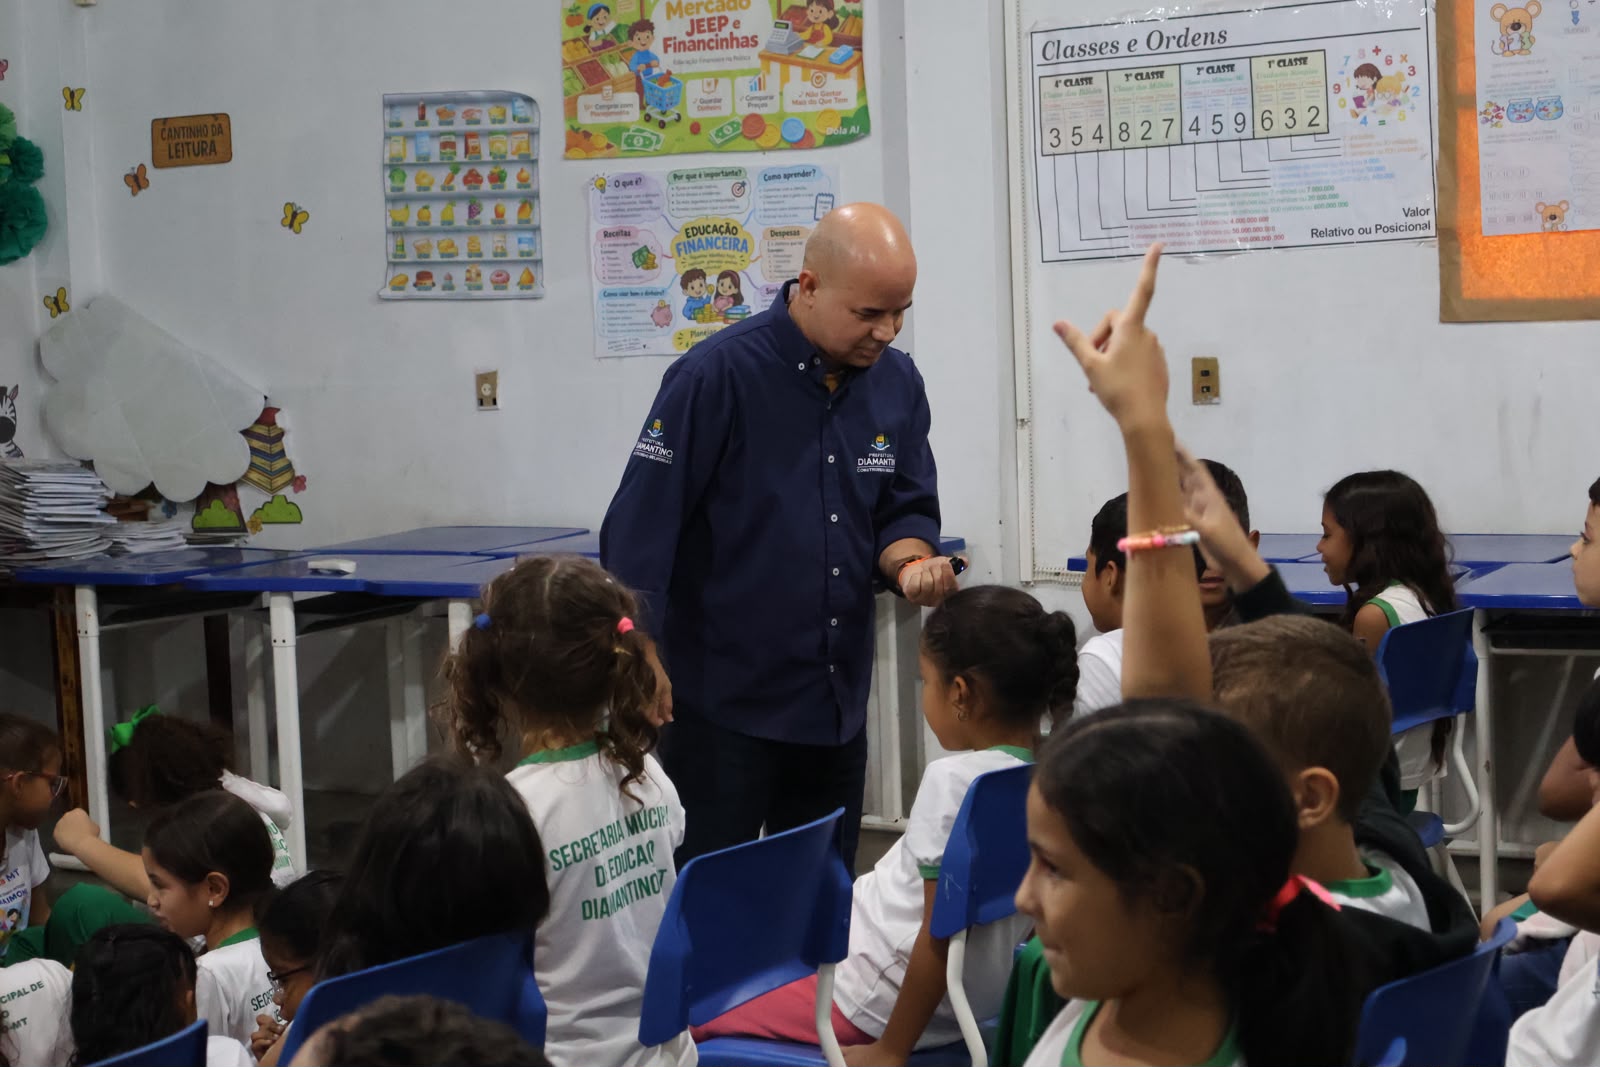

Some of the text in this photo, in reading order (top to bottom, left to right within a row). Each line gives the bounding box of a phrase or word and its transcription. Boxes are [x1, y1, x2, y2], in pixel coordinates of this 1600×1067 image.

[665, 0, 751, 21] Mercado
[685, 15, 741, 37] JEEP e
[663, 31, 759, 54] Financinhas
[1041, 27, 1228, 62] Classes e Ordens
[1206, 64, 1236, 74] CLASSE
[1276, 56, 1309, 68] CLASSE
[1384, 54, 1393, 66] 6
[1134, 70, 1165, 81] CLASSE
[1407, 65, 1416, 77] 3
[1063, 77, 1094, 87] CLASSE
[1333, 83, 1341, 94] 9
[1411, 85, 1421, 97] 2
[1188, 116, 1201, 136] 4
[1211, 114, 1224, 135] 5
[1234, 112, 1246, 133] 9
[1261, 109, 1274, 132] 6
[1284, 107, 1297, 129] 3
[1307, 106, 1320, 128] 2
[161, 123, 224, 140] CANTINHO DA
[1049, 127, 1061, 148] 3
[1071, 126, 1083, 147] 5
[1092, 123, 1104, 144] 4
[1118, 121, 1130, 142] 8
[1140, 120, 1152, 141] 2
[1162, 118, 1175, 139] 7
[168, 140, 217, 160] LEITURA
[614, 180, 620, 188] O
[621, 180, 634, 189] que
[673, 173, 684, 181] Por
[685, 173, 697, 181] que
[763, 168, 816, 182] Como aprender?
[1402, 206, 1431, 218] Valor
[603, 229, 631, 239] Receitas
[685, 222, 739, 239] EDUCAÇÃO
[770, 230, 801, 239] Despesas
[1310, 220, 1431, 239] Relativo ou Posicional
[675, 236, 749, 258] FINANCEIRA
[30, 981, 45, 992] DE
